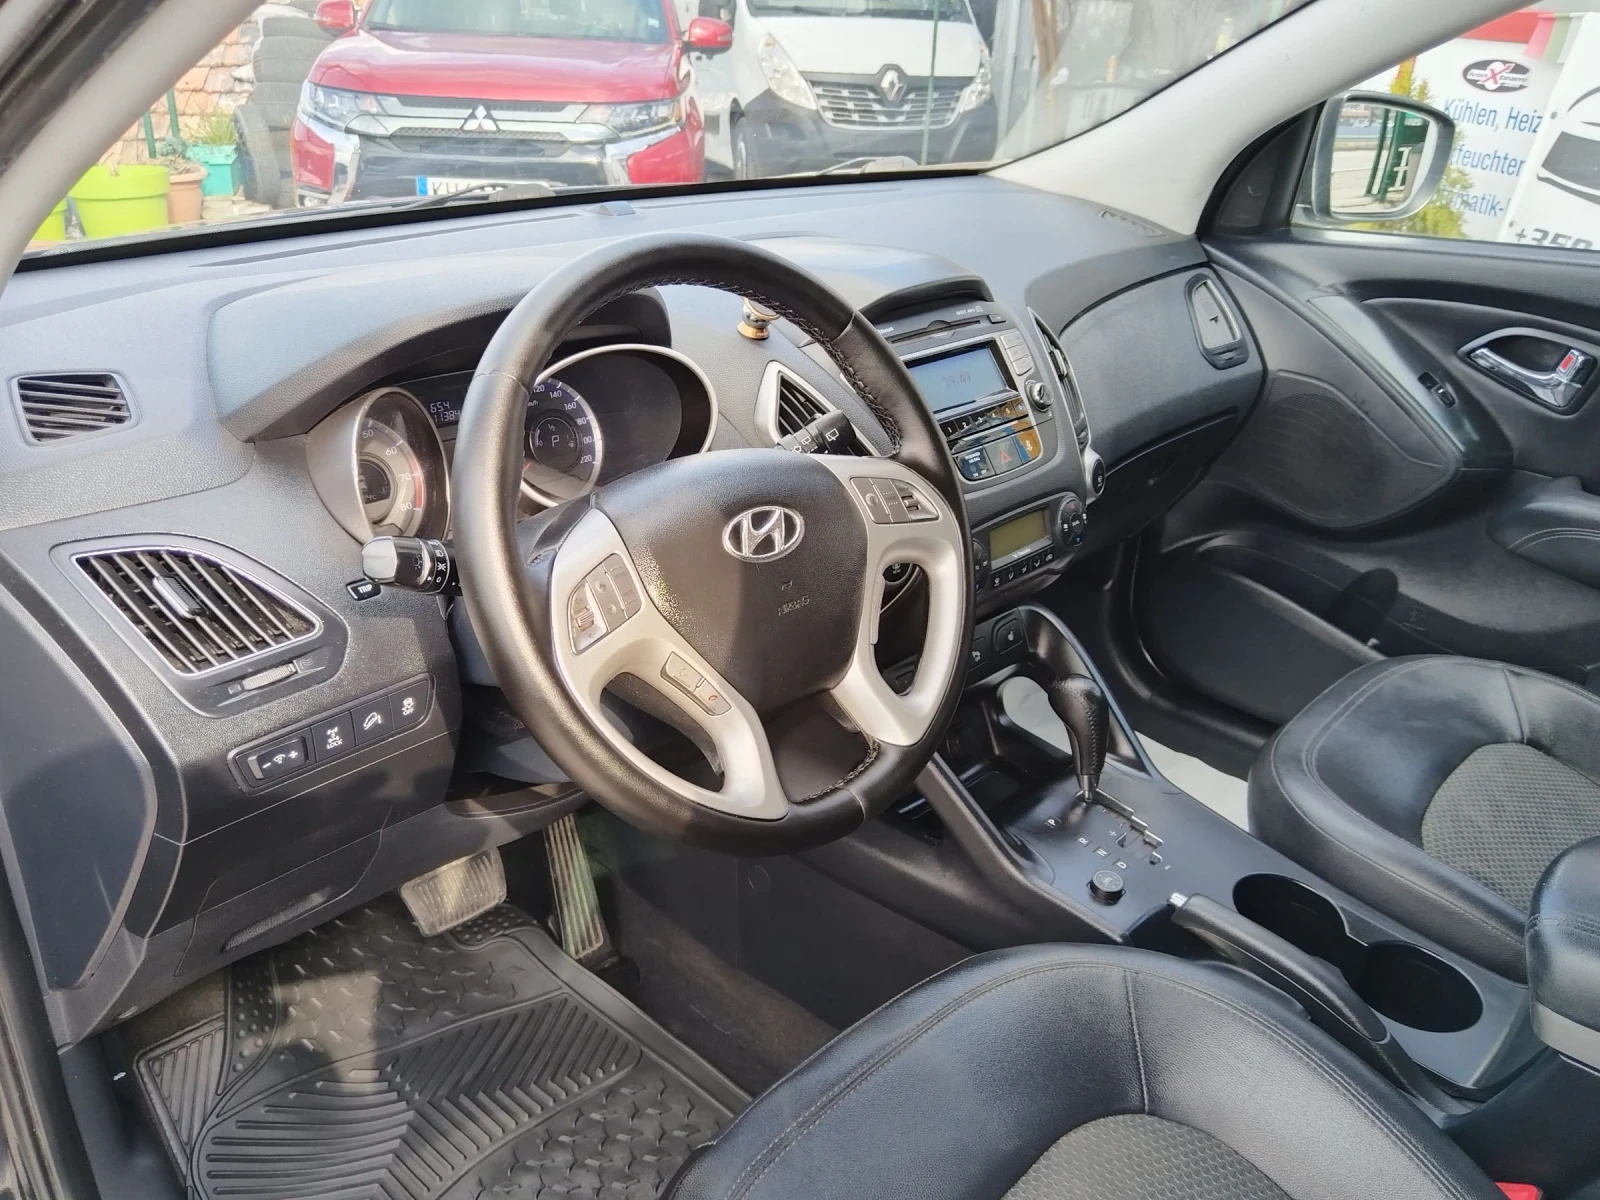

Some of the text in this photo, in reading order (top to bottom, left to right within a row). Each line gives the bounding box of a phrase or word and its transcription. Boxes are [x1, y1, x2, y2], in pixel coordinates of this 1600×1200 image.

[1444, 98, 1544, 133] Kühlen, Heiz
[549, 390, 562, 398] 140
[564, 402, 577, 410] 160
[362, 429, 374, 438] 50
[385, 446, 398, 456] 60
[399, 472, 412, 482] 70
[400, 502, 413, 512] 80
[357, 584, 373, 594] TRIP
[326, 739, 343, 749] LOCK
